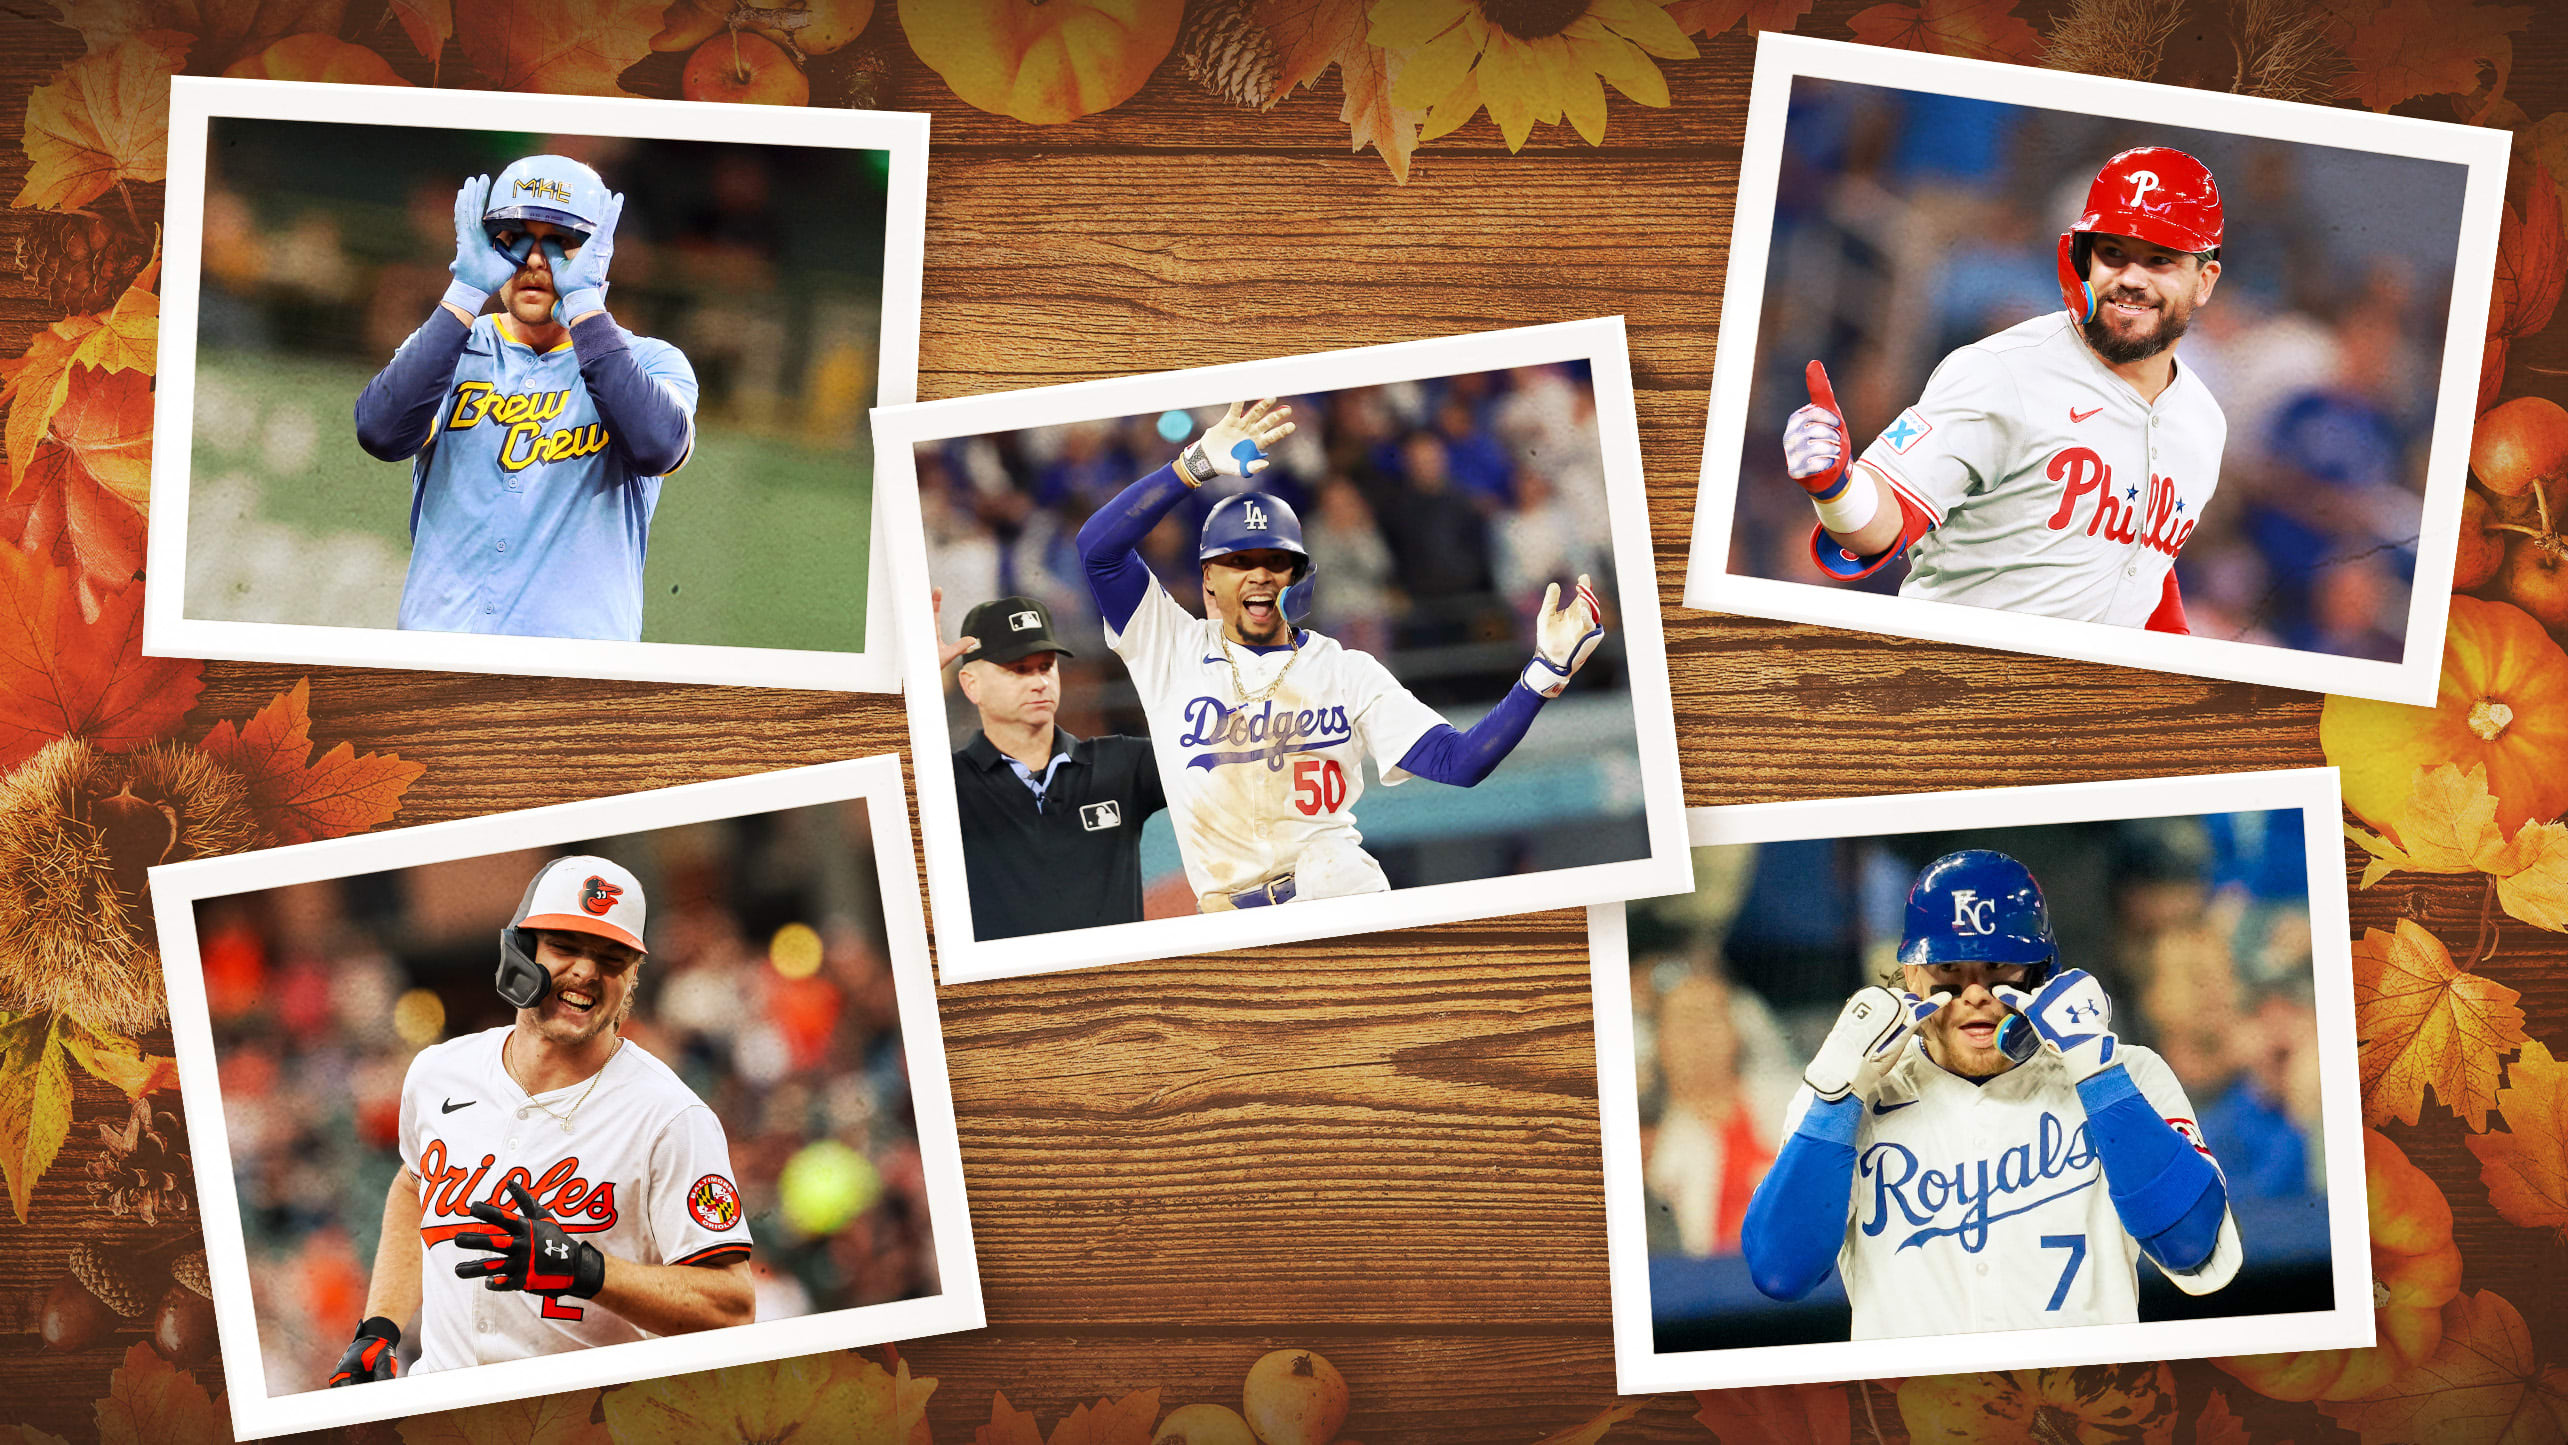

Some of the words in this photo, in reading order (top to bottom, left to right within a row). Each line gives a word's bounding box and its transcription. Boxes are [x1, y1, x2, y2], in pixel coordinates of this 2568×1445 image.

[512, 178, 571, 204] MKE
[2129, 170, 2159, 207] P
[444, 380, 571, 432] Brew
[497, 421, 610, 473] Crew
[1243, 500, 1268, 530] LA
[1179, 696, 1352, 773] Dodgers
[1293, 760, 1347, 816] 50
[1951, 889, 1996, 935] KC
[420, 1138, 618, 1220] Orioles
[690, 1176, 734, 1199] BALTIMORE
[1860, 1111, 2098, 1254] Royals
[702, 1215, 737, 1230] ORIOLES
[2040, 1234, 2086, 1311] 7
